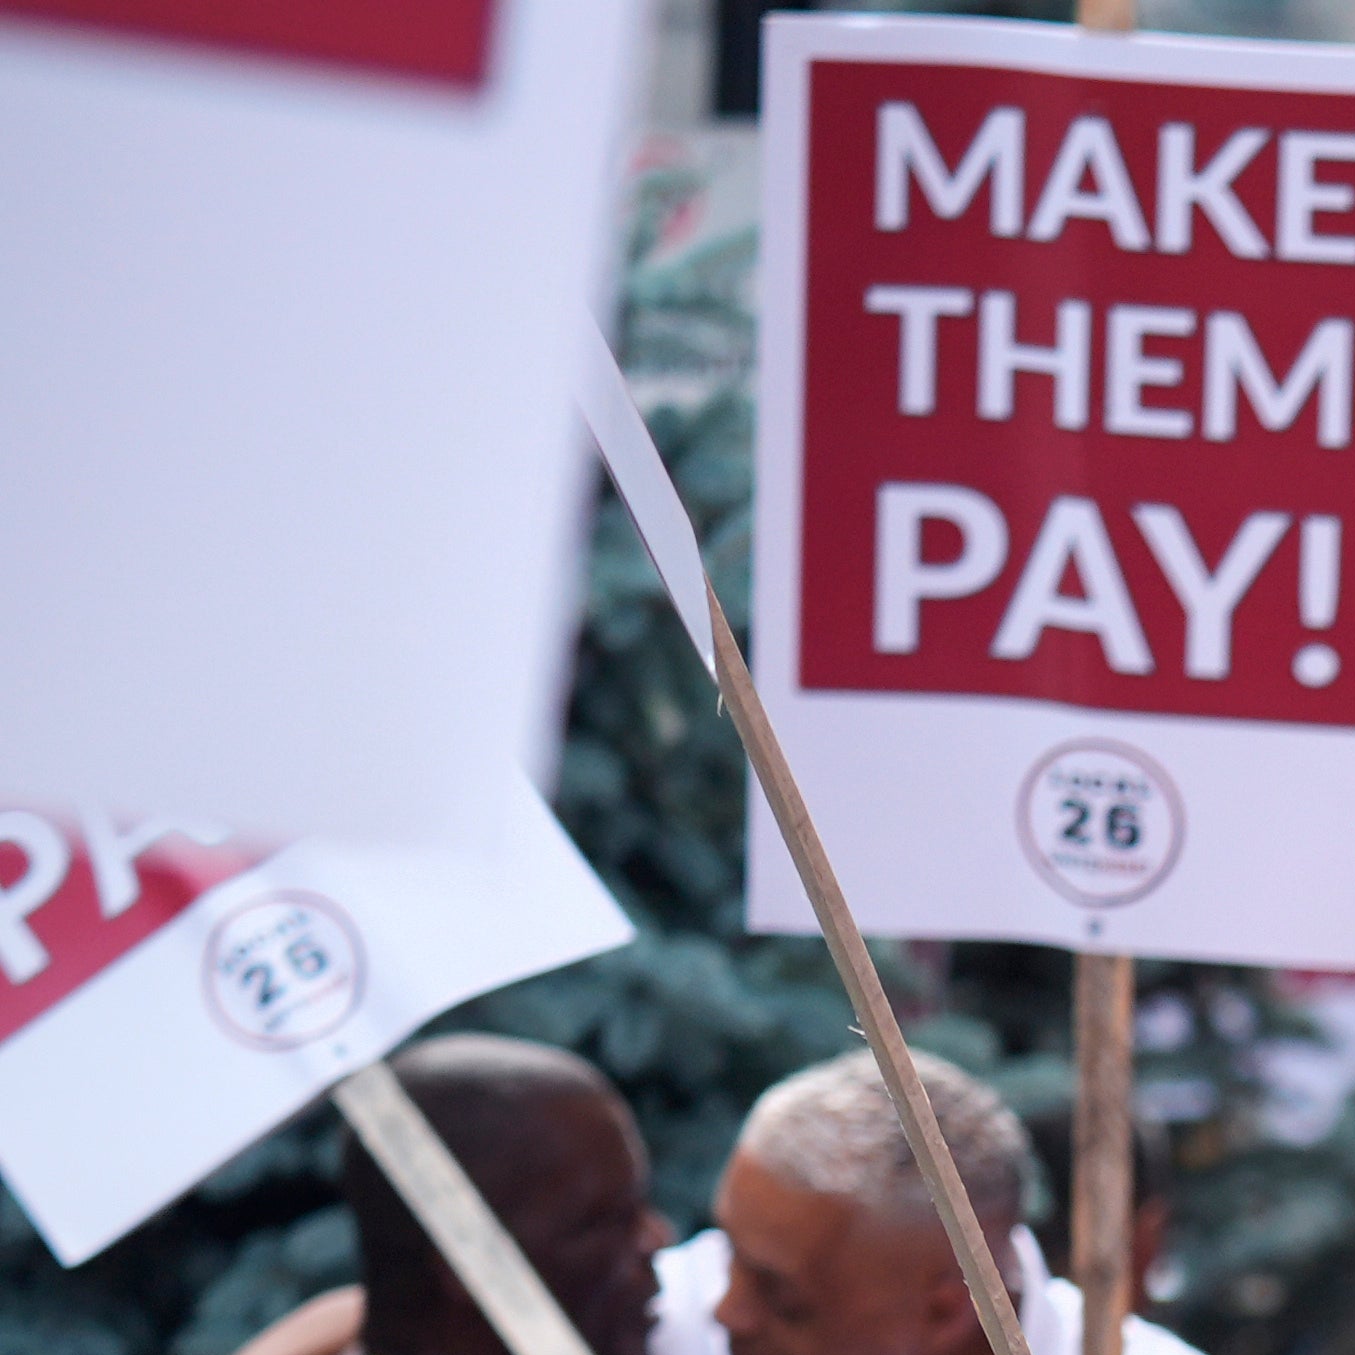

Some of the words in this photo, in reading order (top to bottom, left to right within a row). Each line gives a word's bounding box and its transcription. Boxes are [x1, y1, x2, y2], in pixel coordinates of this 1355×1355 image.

[864, 286, 1355, 450] THEM
[872, 482, 1343, 690] PAY!
[1060, 799, 1141, 849] 26
[241, 935, 331, 1010] 26
